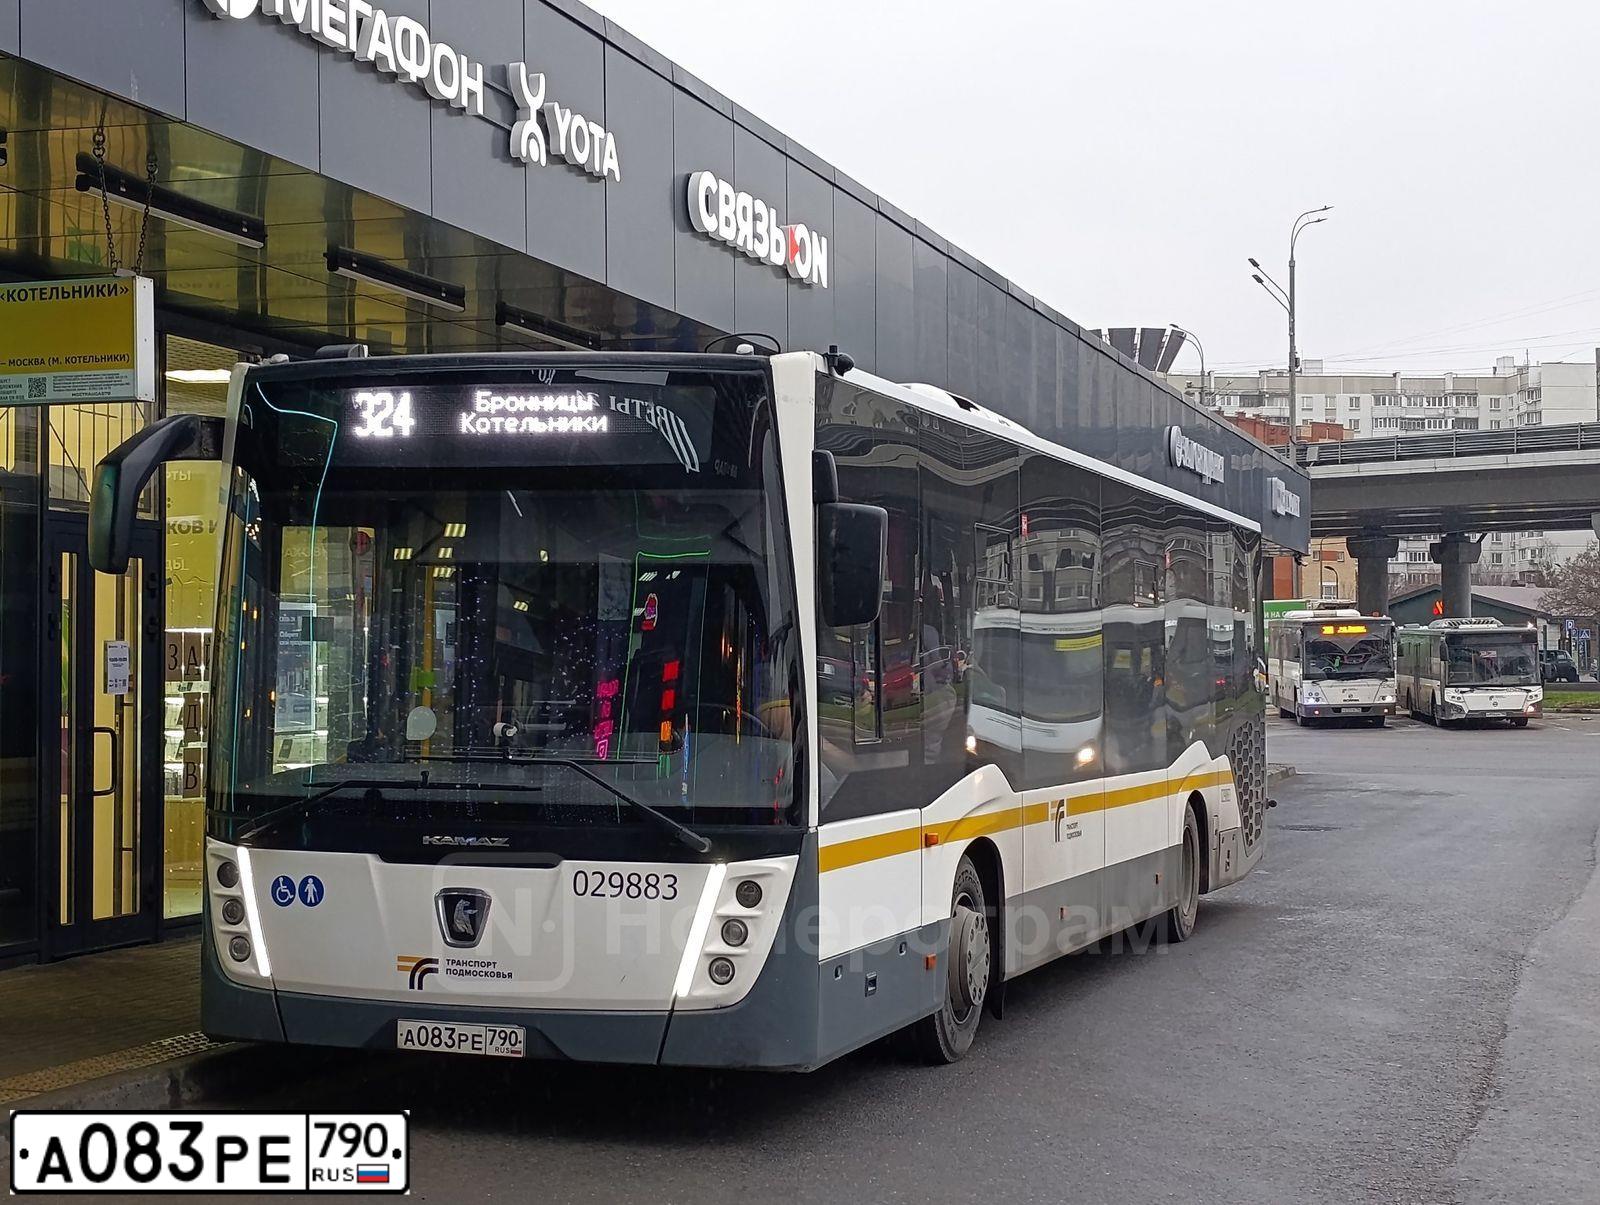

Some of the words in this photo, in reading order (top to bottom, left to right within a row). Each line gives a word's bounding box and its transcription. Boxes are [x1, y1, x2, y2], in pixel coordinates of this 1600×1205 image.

[546, 102, 621, 183] YOTA
[8, 357, 45, 367] МОСКВА
[474, 389, 594, 415] Бронницы
[353, 391, 415, 438] 324
[460, 411, 608, 435] Котельники
[422, 835, 510, 847] KAMAZ
[572, 869, 678, 901] 029883
[445, 958, 497, 969] ТРАНСПОРТ
[445, 968, 513, 980] ПОДМОСКОВЬЯ
[488, 1028, 518, 1047] 790
[494, 1046, 510, 1054] RUS
